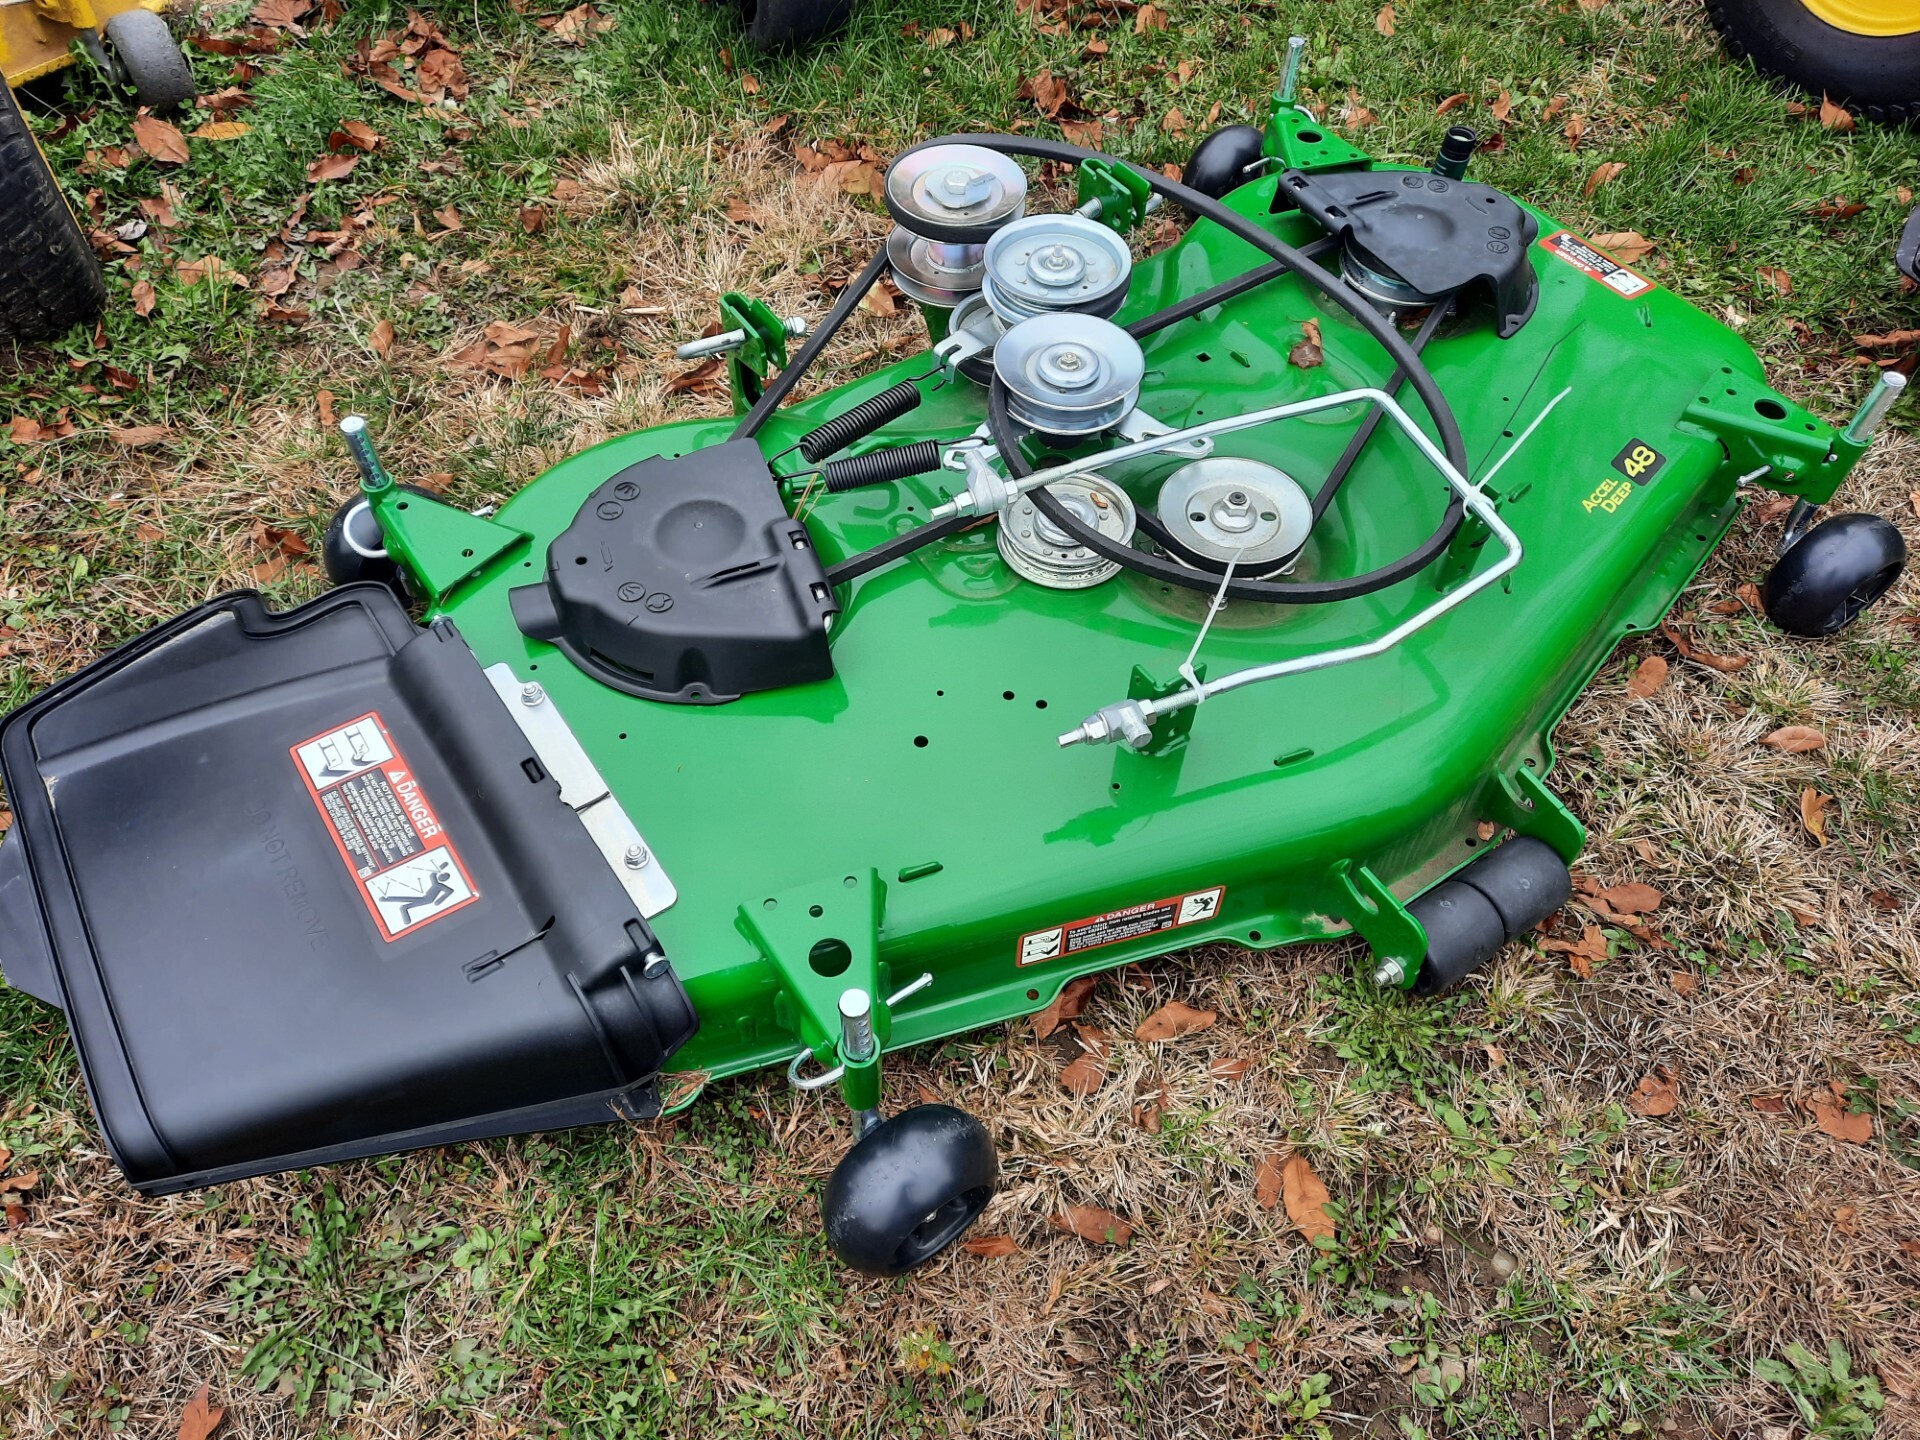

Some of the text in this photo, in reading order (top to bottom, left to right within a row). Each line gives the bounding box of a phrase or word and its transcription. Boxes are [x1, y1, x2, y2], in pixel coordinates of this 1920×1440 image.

[1624, 446, 1656, 477] 48
[1582, 479, 1619, 513] ACCEL
[1600, 481, 1632, 514] DEEP
[334, 797, 343, 807] NOT
[339, 806, 354, 828] OPERATE
[350, 827, 364, 847] MOWER
[359, 845, 376, 869] WITHOUT
[339, 783, 350, 795] THAT
[353, 809, 368, 829] THROWN
[363, 827, 371, 835] BY
[357, 787, 396, 849] THROWN OBJECTS
[359, 775, 370, 786] INTO
[373, 800, 385, 815] WHEN
[392, 835, 408, 857] RUNNING
[362, 812, 374, 827] CLEAR
[369, 825, 380, 838] AREA
[379, 843, 394, 863] OBJECTS
[369, 779, 379, 789] NOT
[374, 787, 383, 797] PUT
[391, 818, 401, 830] FEET
[397, 829, 410, 845] UNDER
[378, 780, 415, 838] ROTATING BLADE
[396, 781, 438, 839] DANGER
[257, 825, 292, 864] NOT
[275, 864, 332, 953] REMOVE
[1106, 903, 1156, 920] DANGER
